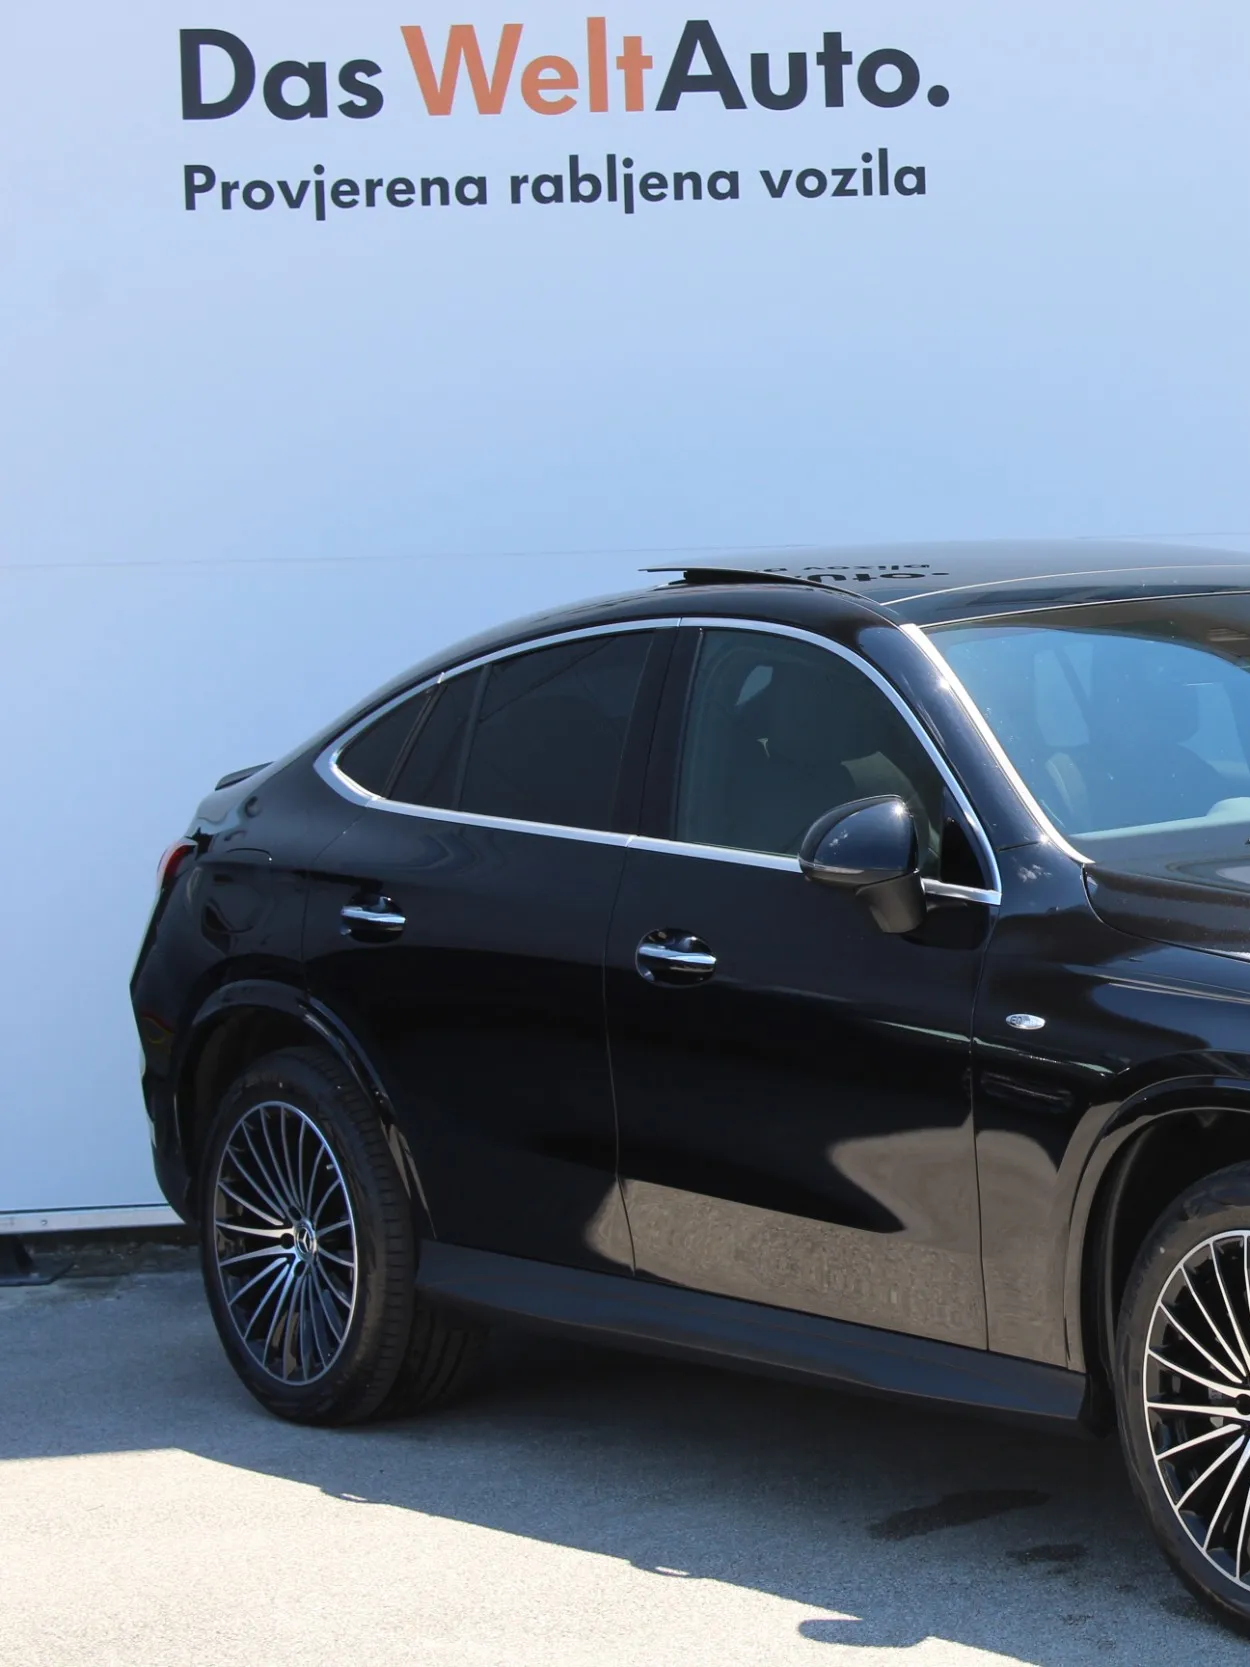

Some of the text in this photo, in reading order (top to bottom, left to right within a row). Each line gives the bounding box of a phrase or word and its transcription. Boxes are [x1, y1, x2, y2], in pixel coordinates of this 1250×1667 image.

[179, 17, 950, 120] Das WeltAuto.
[184, 147, 926, 221] Provjerena rabljena vozila
